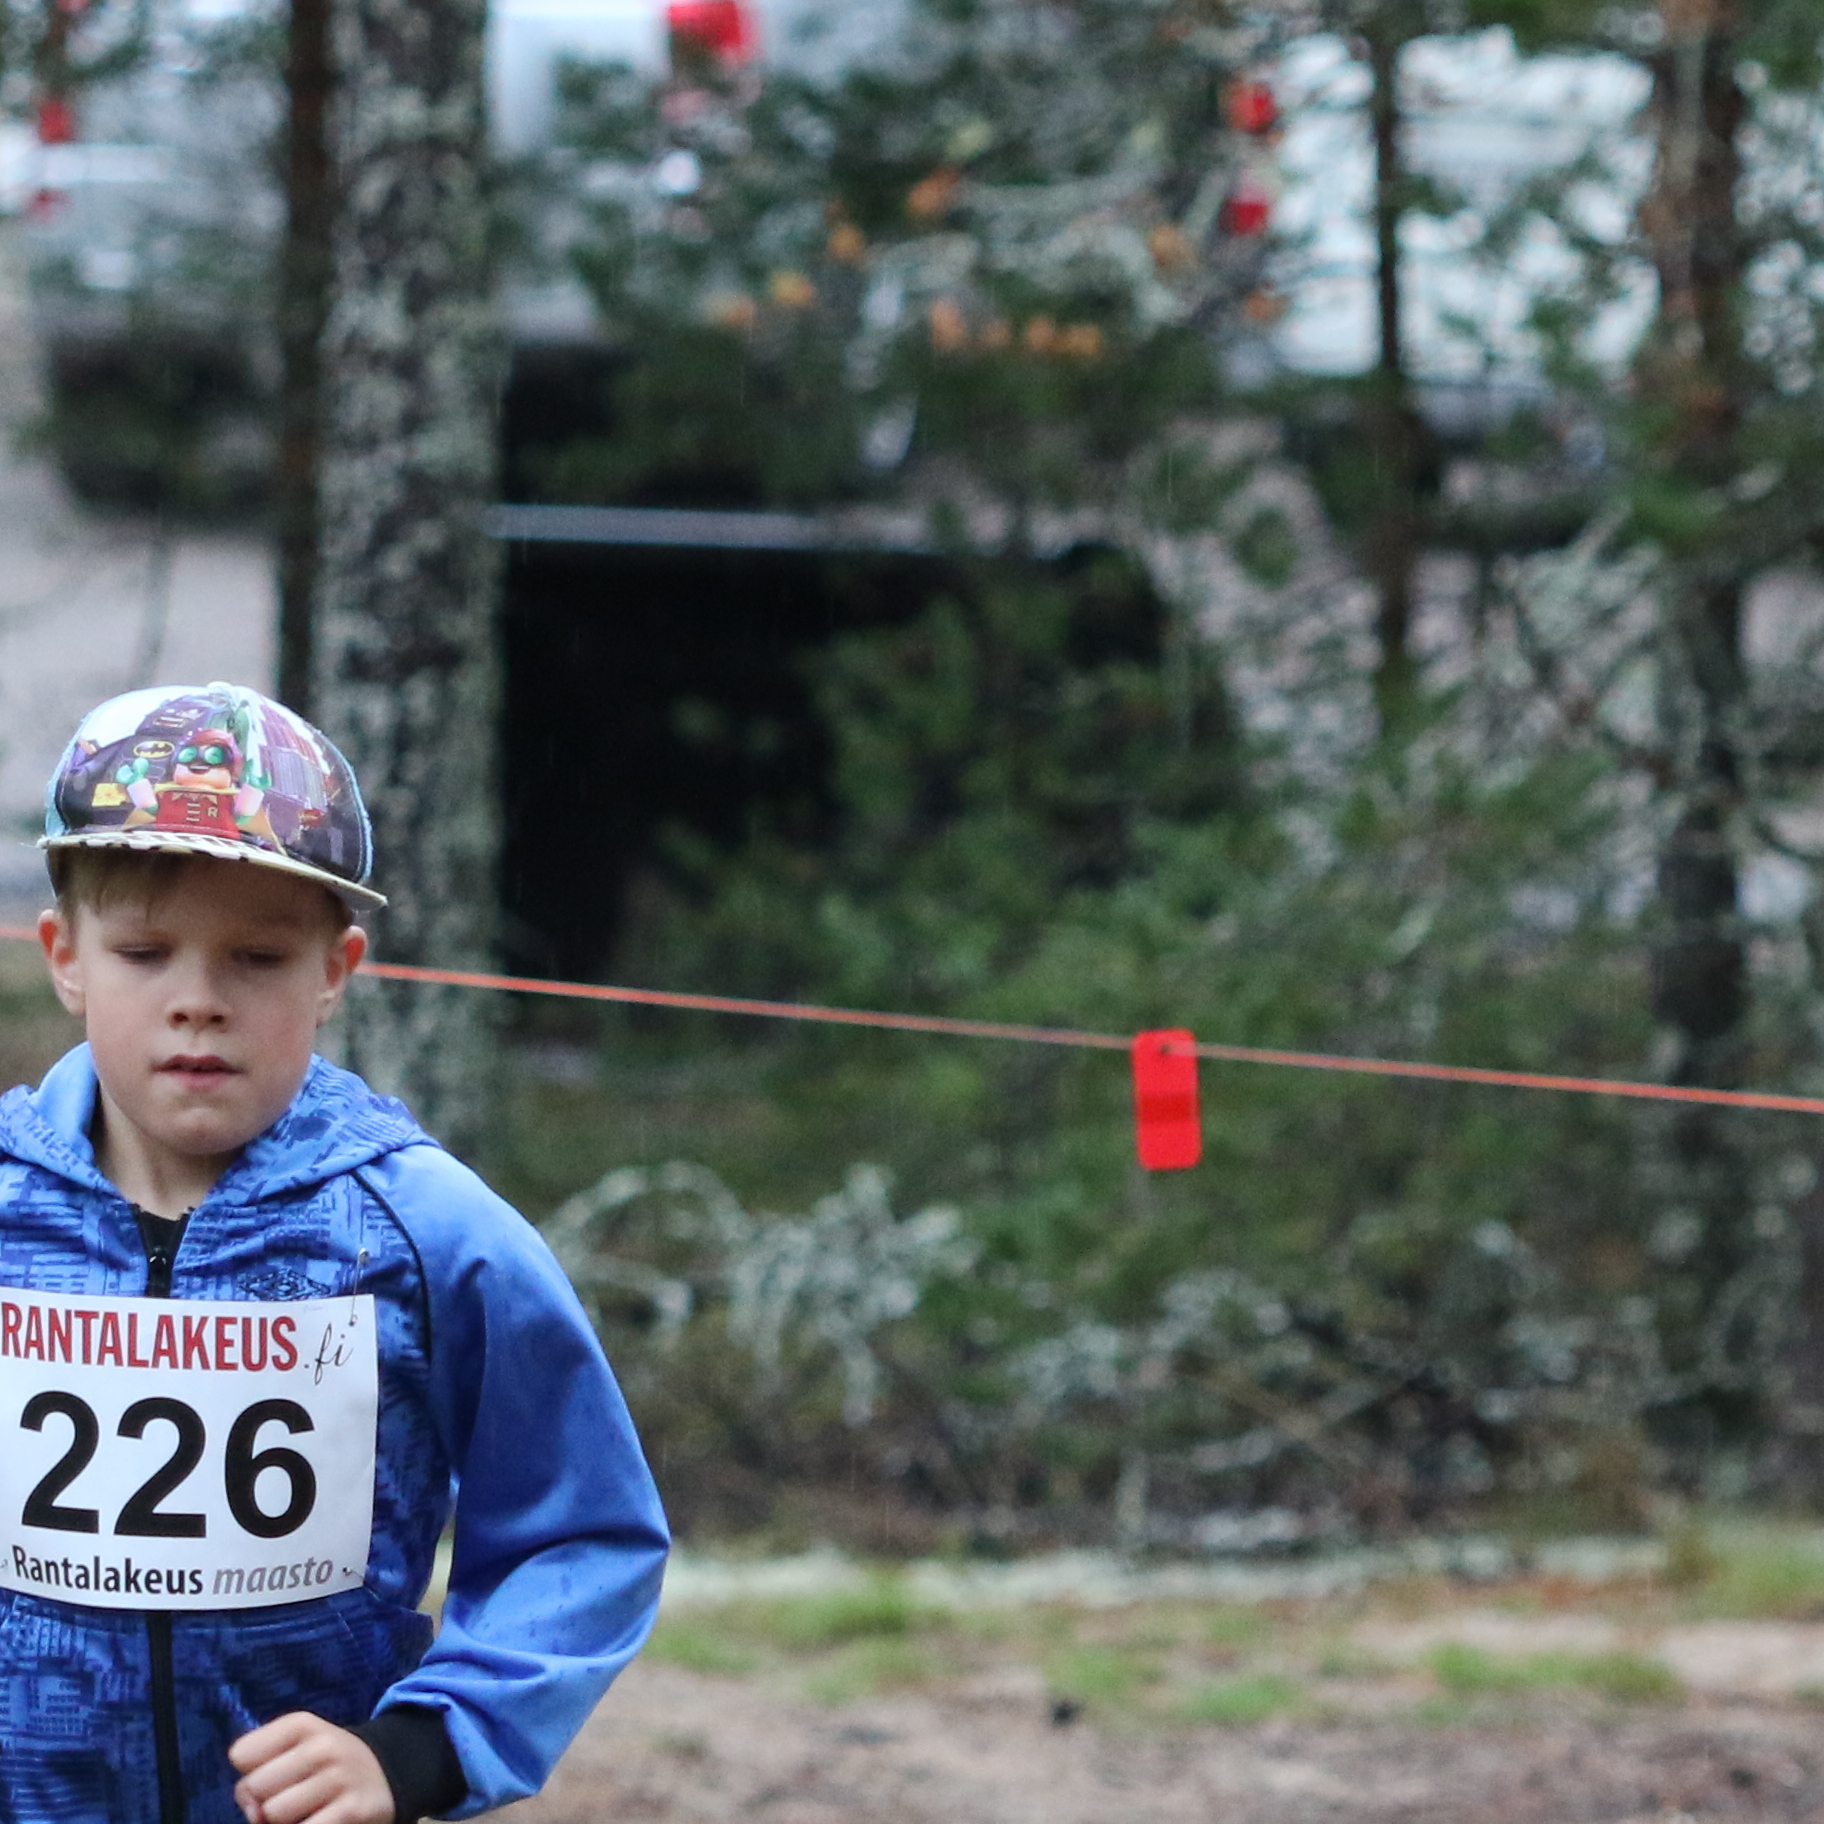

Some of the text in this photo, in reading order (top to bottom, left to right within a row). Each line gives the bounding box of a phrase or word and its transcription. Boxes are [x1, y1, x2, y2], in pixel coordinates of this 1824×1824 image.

[19, 1390, 317, 1539] 226
[12, 1545, 334, 1595] Rantalakeus maasto
